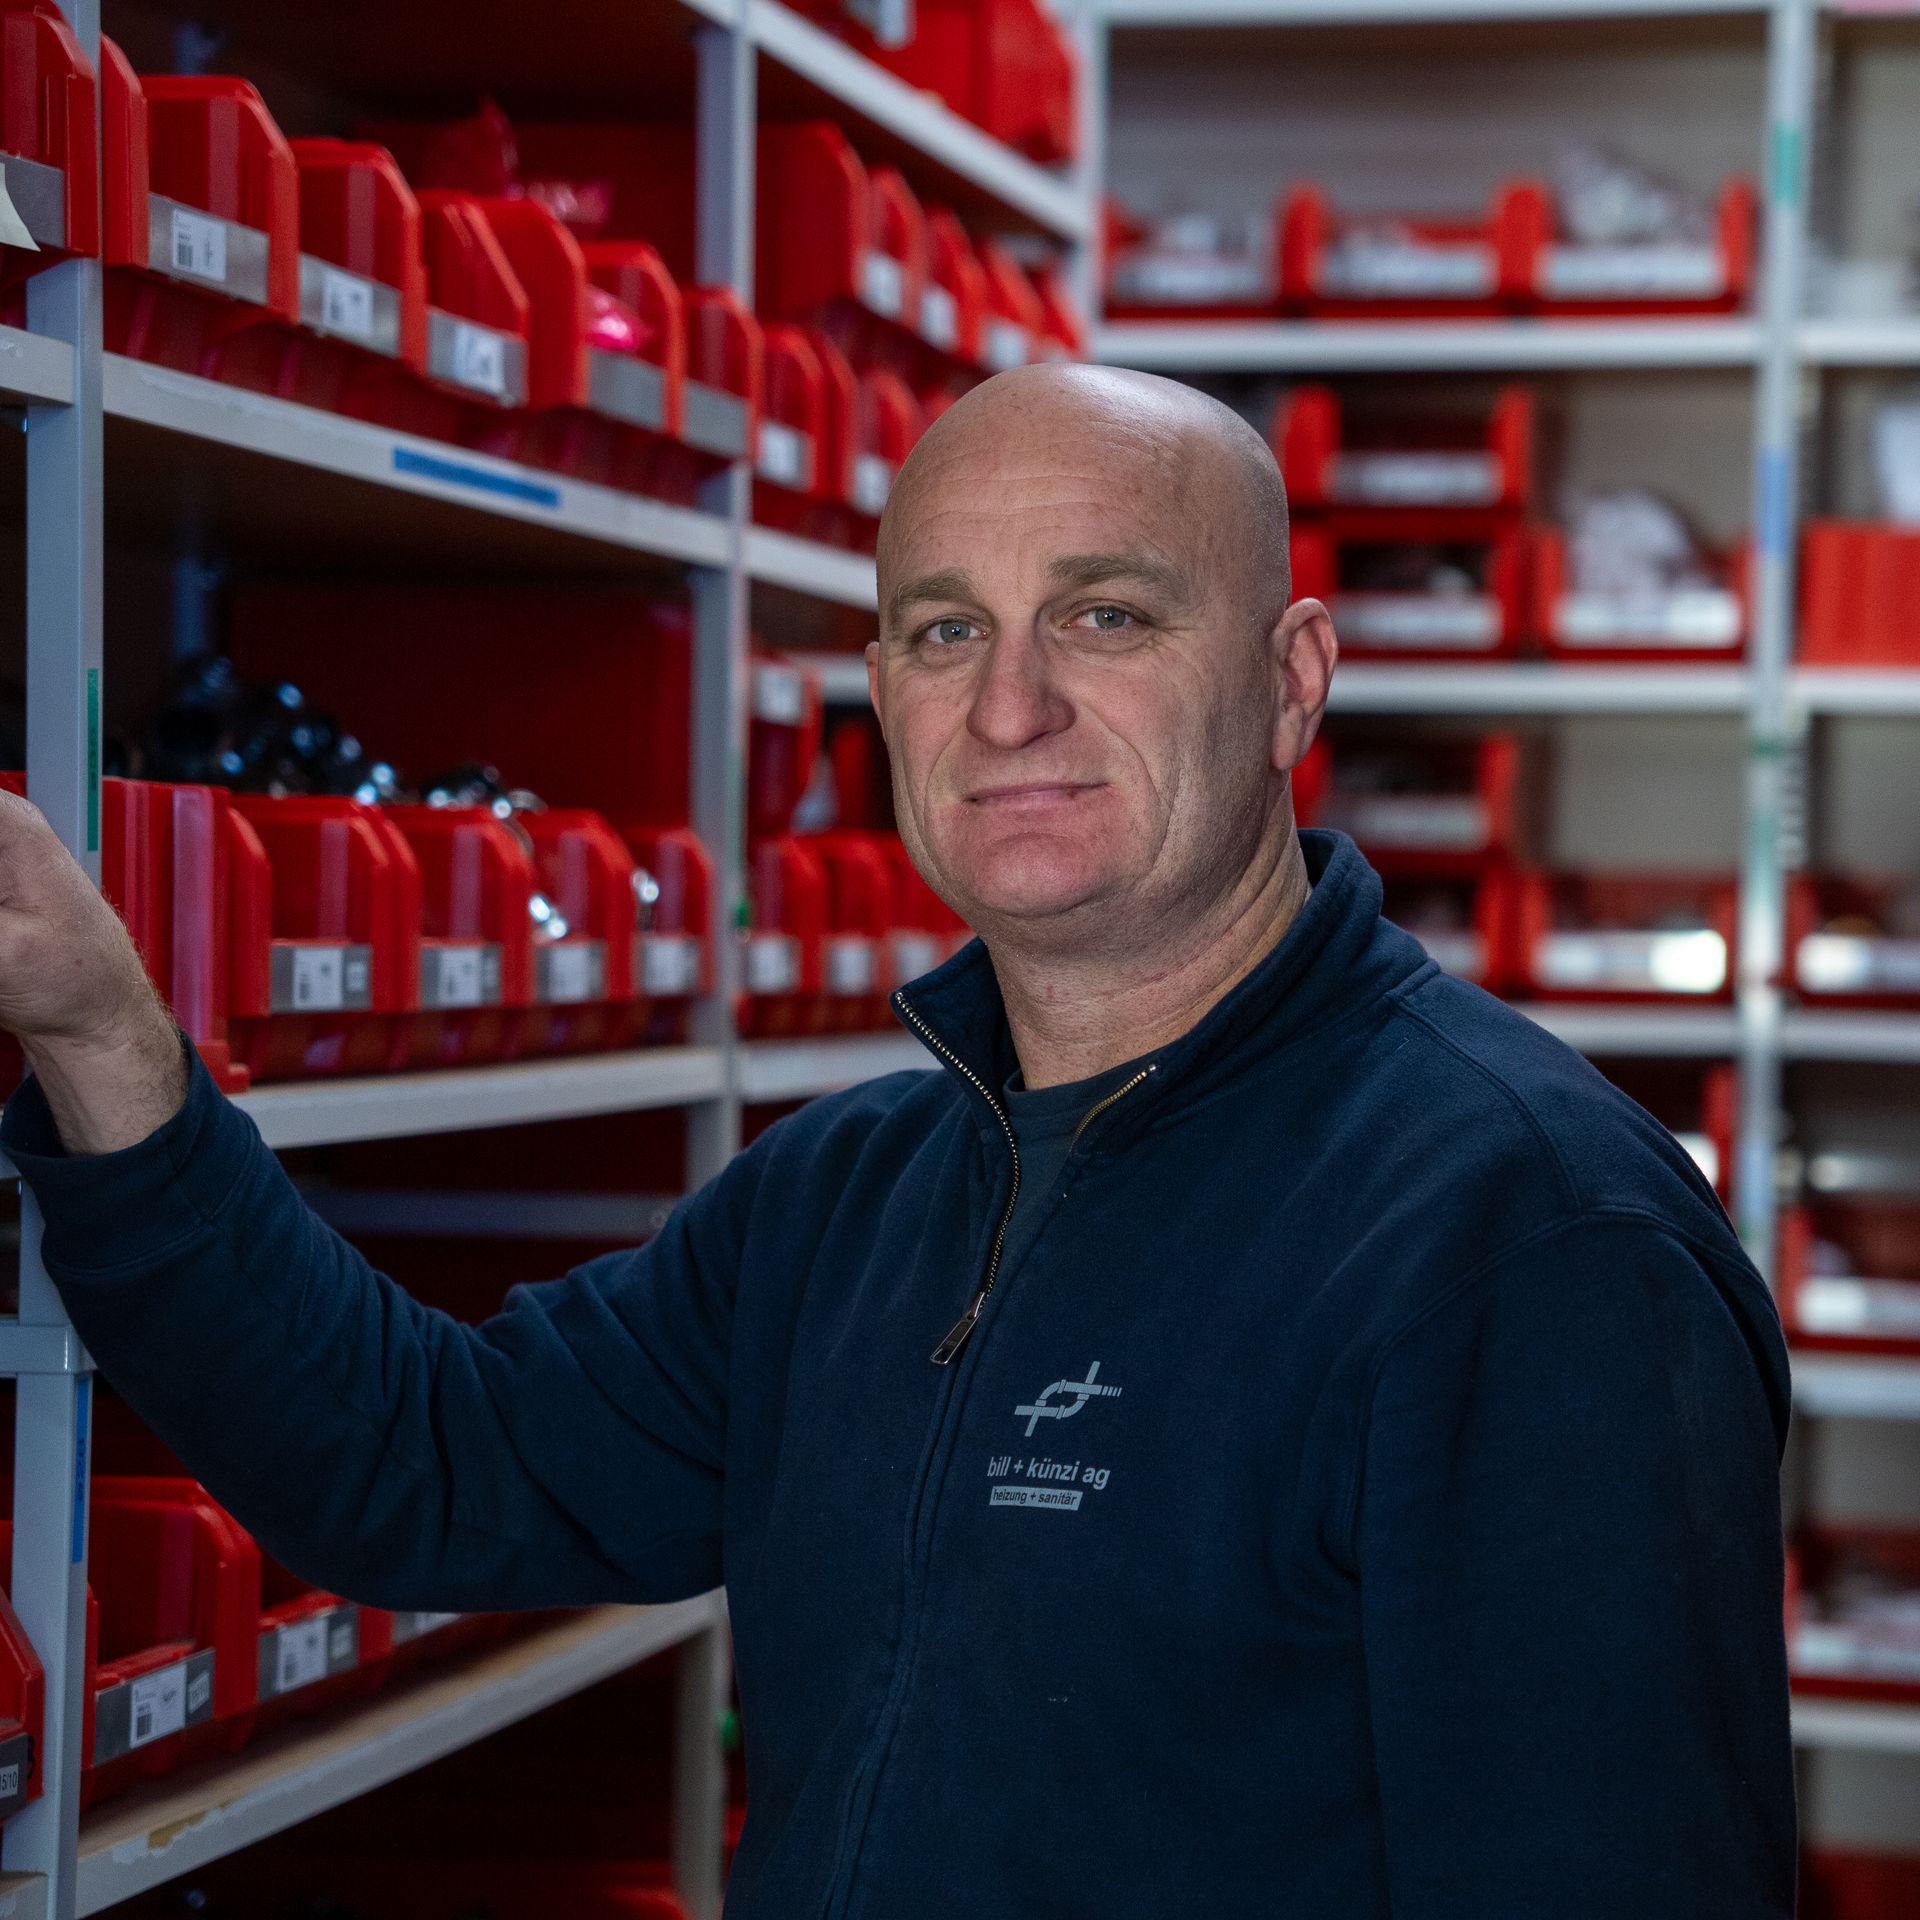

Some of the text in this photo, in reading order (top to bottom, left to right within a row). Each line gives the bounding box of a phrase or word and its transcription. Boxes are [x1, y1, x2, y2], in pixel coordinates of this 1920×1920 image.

[987, 1456, 1111, 1490] bill + künzi ag
[993, 1488, 1077, 1505] heizung + sanitär
